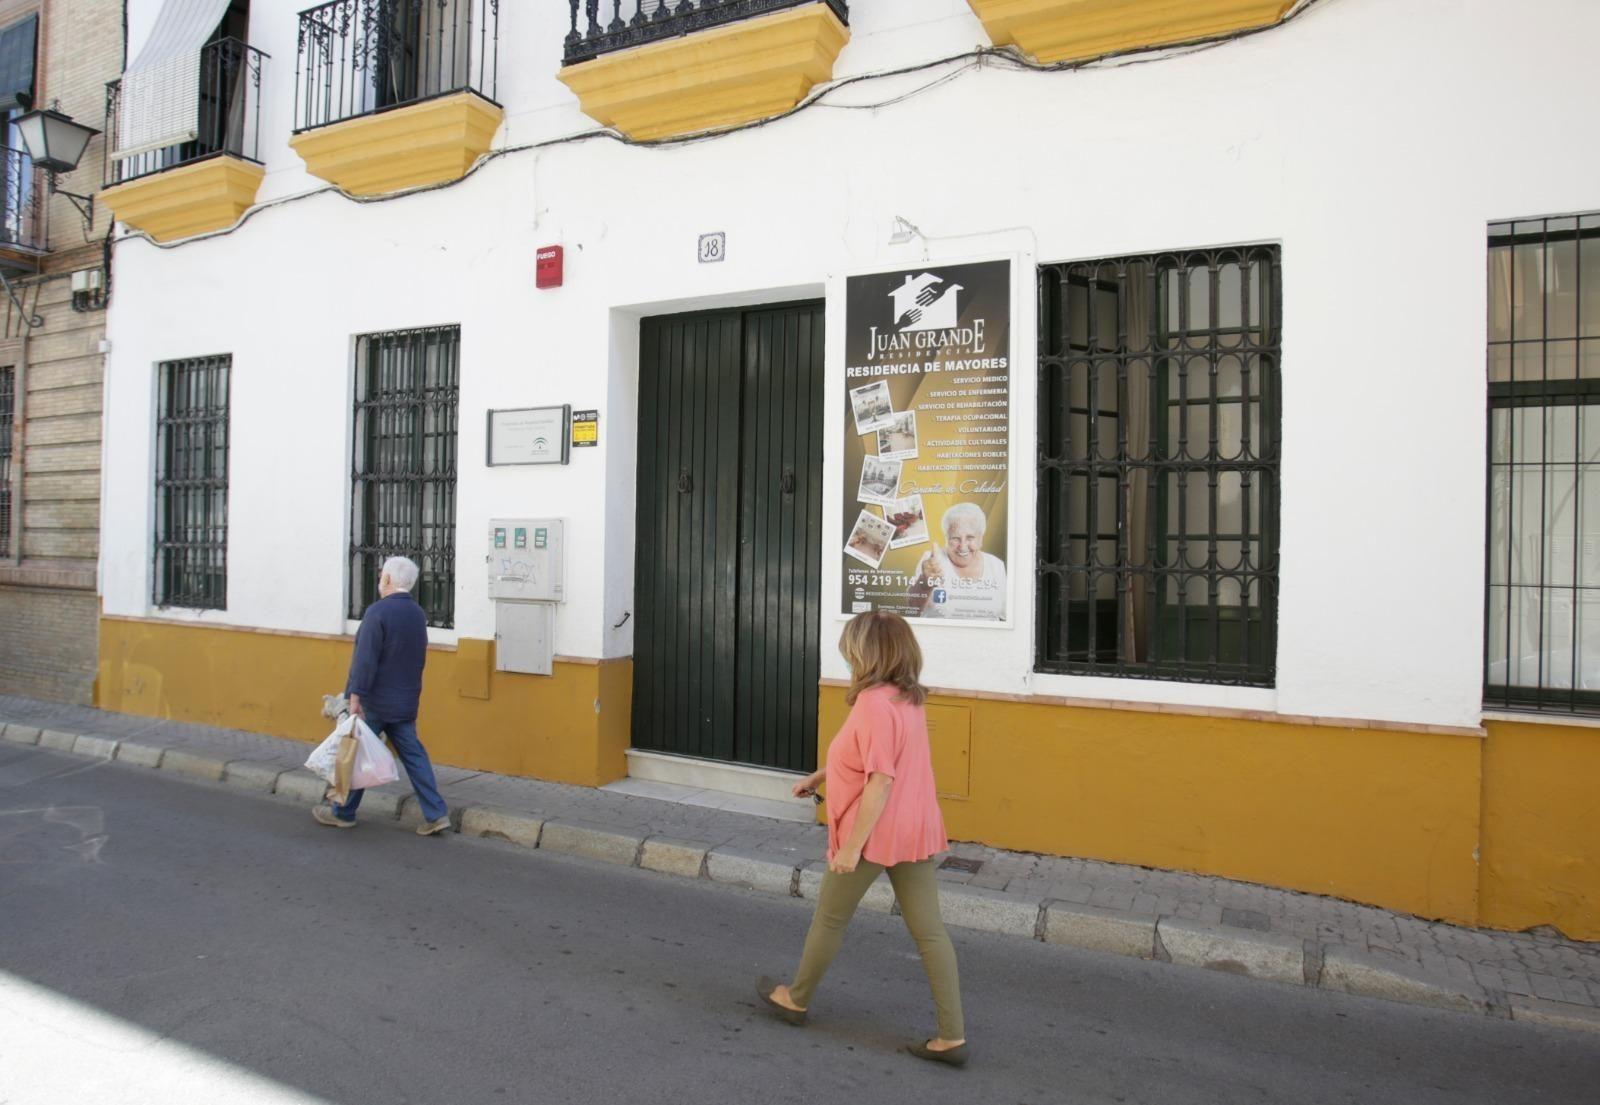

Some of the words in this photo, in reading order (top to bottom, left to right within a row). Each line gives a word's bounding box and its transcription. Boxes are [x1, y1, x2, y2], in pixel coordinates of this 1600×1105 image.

[704, 238, 719, 258] 18
[537, 250, 556, 260] FUEGO
[867, 326, 911, 361] JUAN
[915, 318, 985, 354] GRANDE
[846, 363, 920, 378] RESIDENCIA
[924, 362, 941, 372] DE
[945, 357, 1008, 371] MAYORES
[953, 376, 980, 384] SERVICIO
[982, 375, 1008, 383] MEDICO
[929, 390, 957, 398] SERVICIO
[968, 388, 1008, 396] ENFERMERIA
[918, 402, 945, 410] SERVICIO
[956, 400, 1008, 408] REHABILITACIÓN
[963, 413, 1007, 421] OCUPACIONAL
[968, 438, 1007, 446] CULTURALES
[917, 464, 961, 472] HABITACIONES
[963, 463, 1007, 471] INDIVIDUALES
[848, 574, 868, 585] 954
[871, 575, 891, 586] 219
[896, 575, 916, 587] 114
